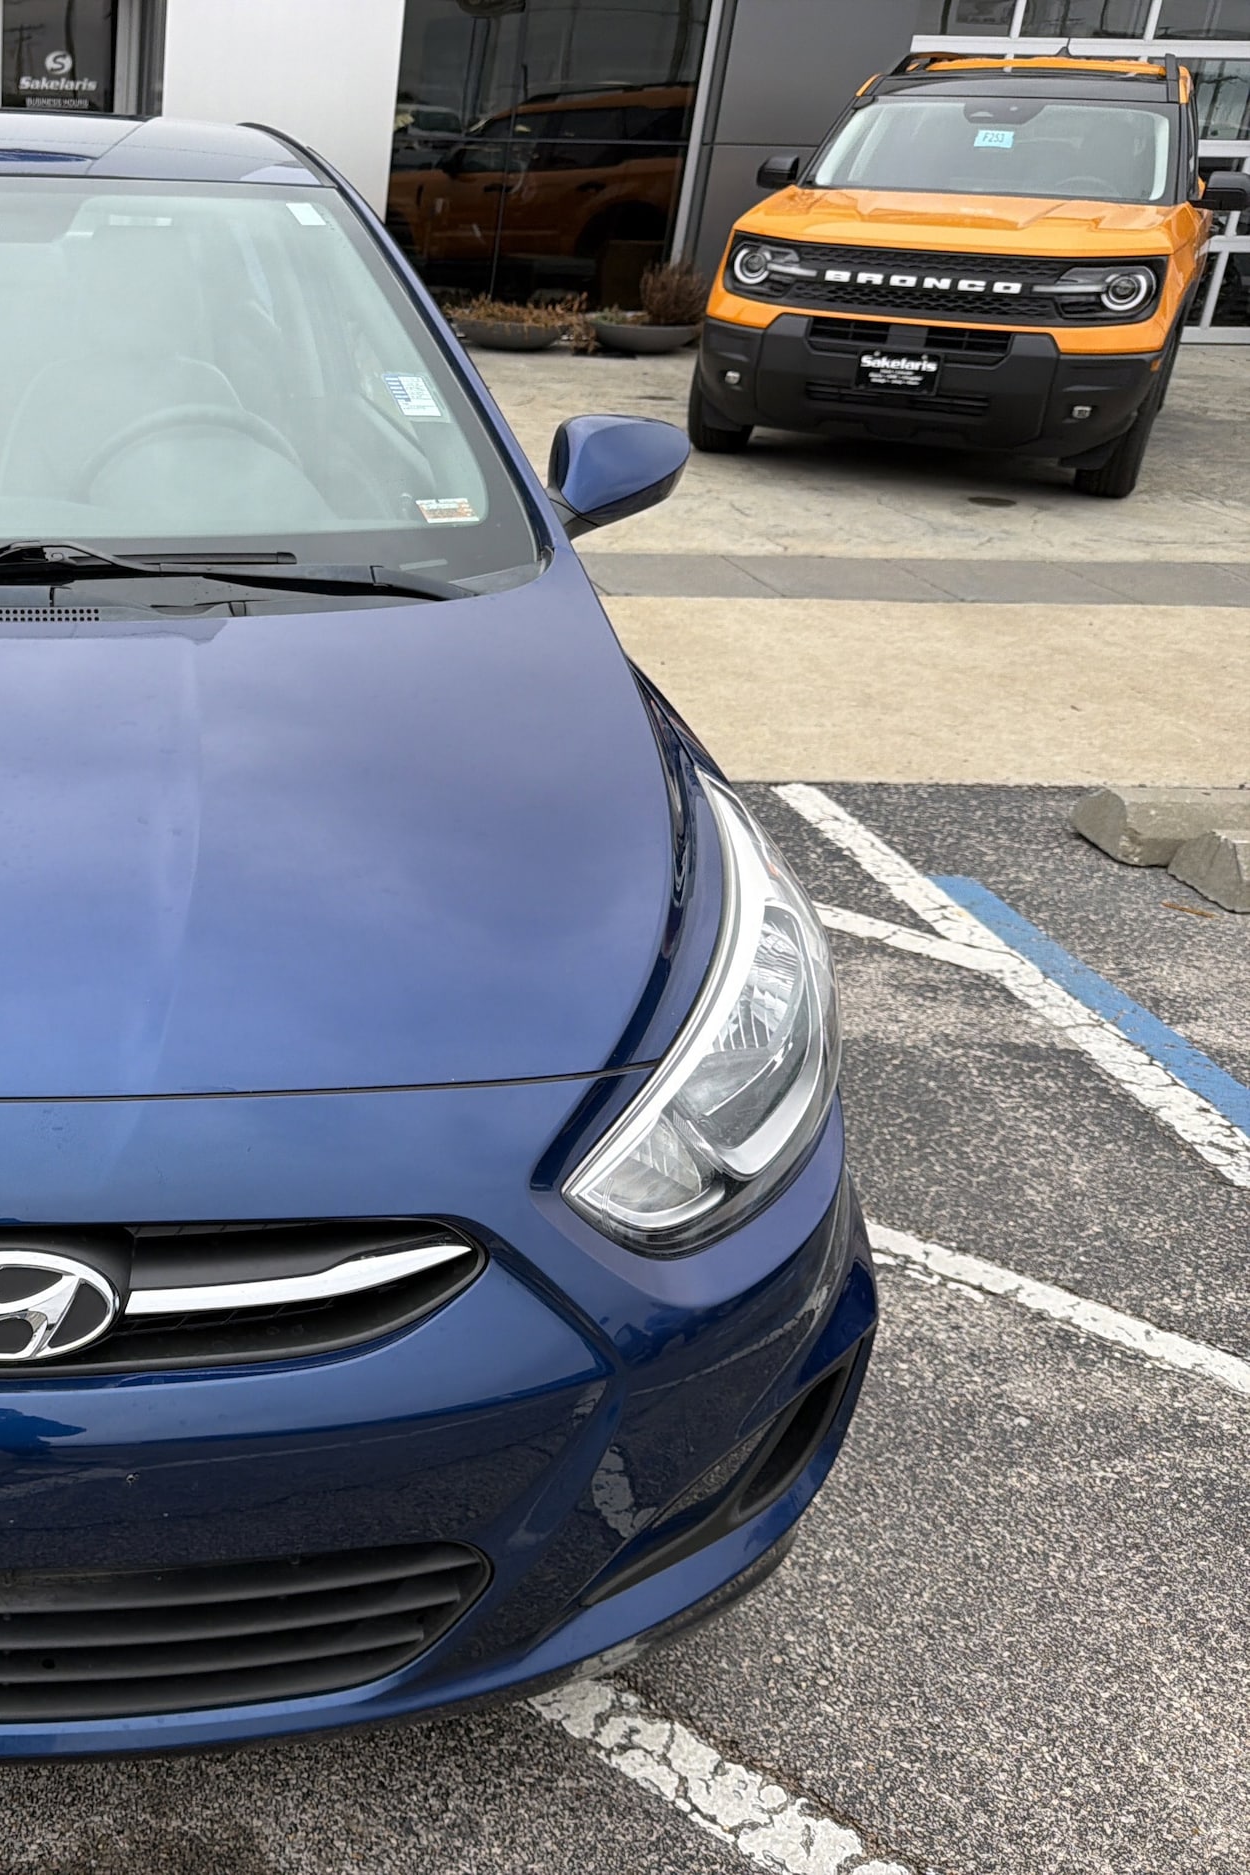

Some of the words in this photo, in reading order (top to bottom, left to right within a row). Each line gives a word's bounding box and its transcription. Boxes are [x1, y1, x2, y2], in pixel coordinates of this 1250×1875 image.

[18, 76, 98, 91] Sakelaris
[824, 269, 1022, 294] BRONCO
[860, 354, 938, 373] Sakelaris
